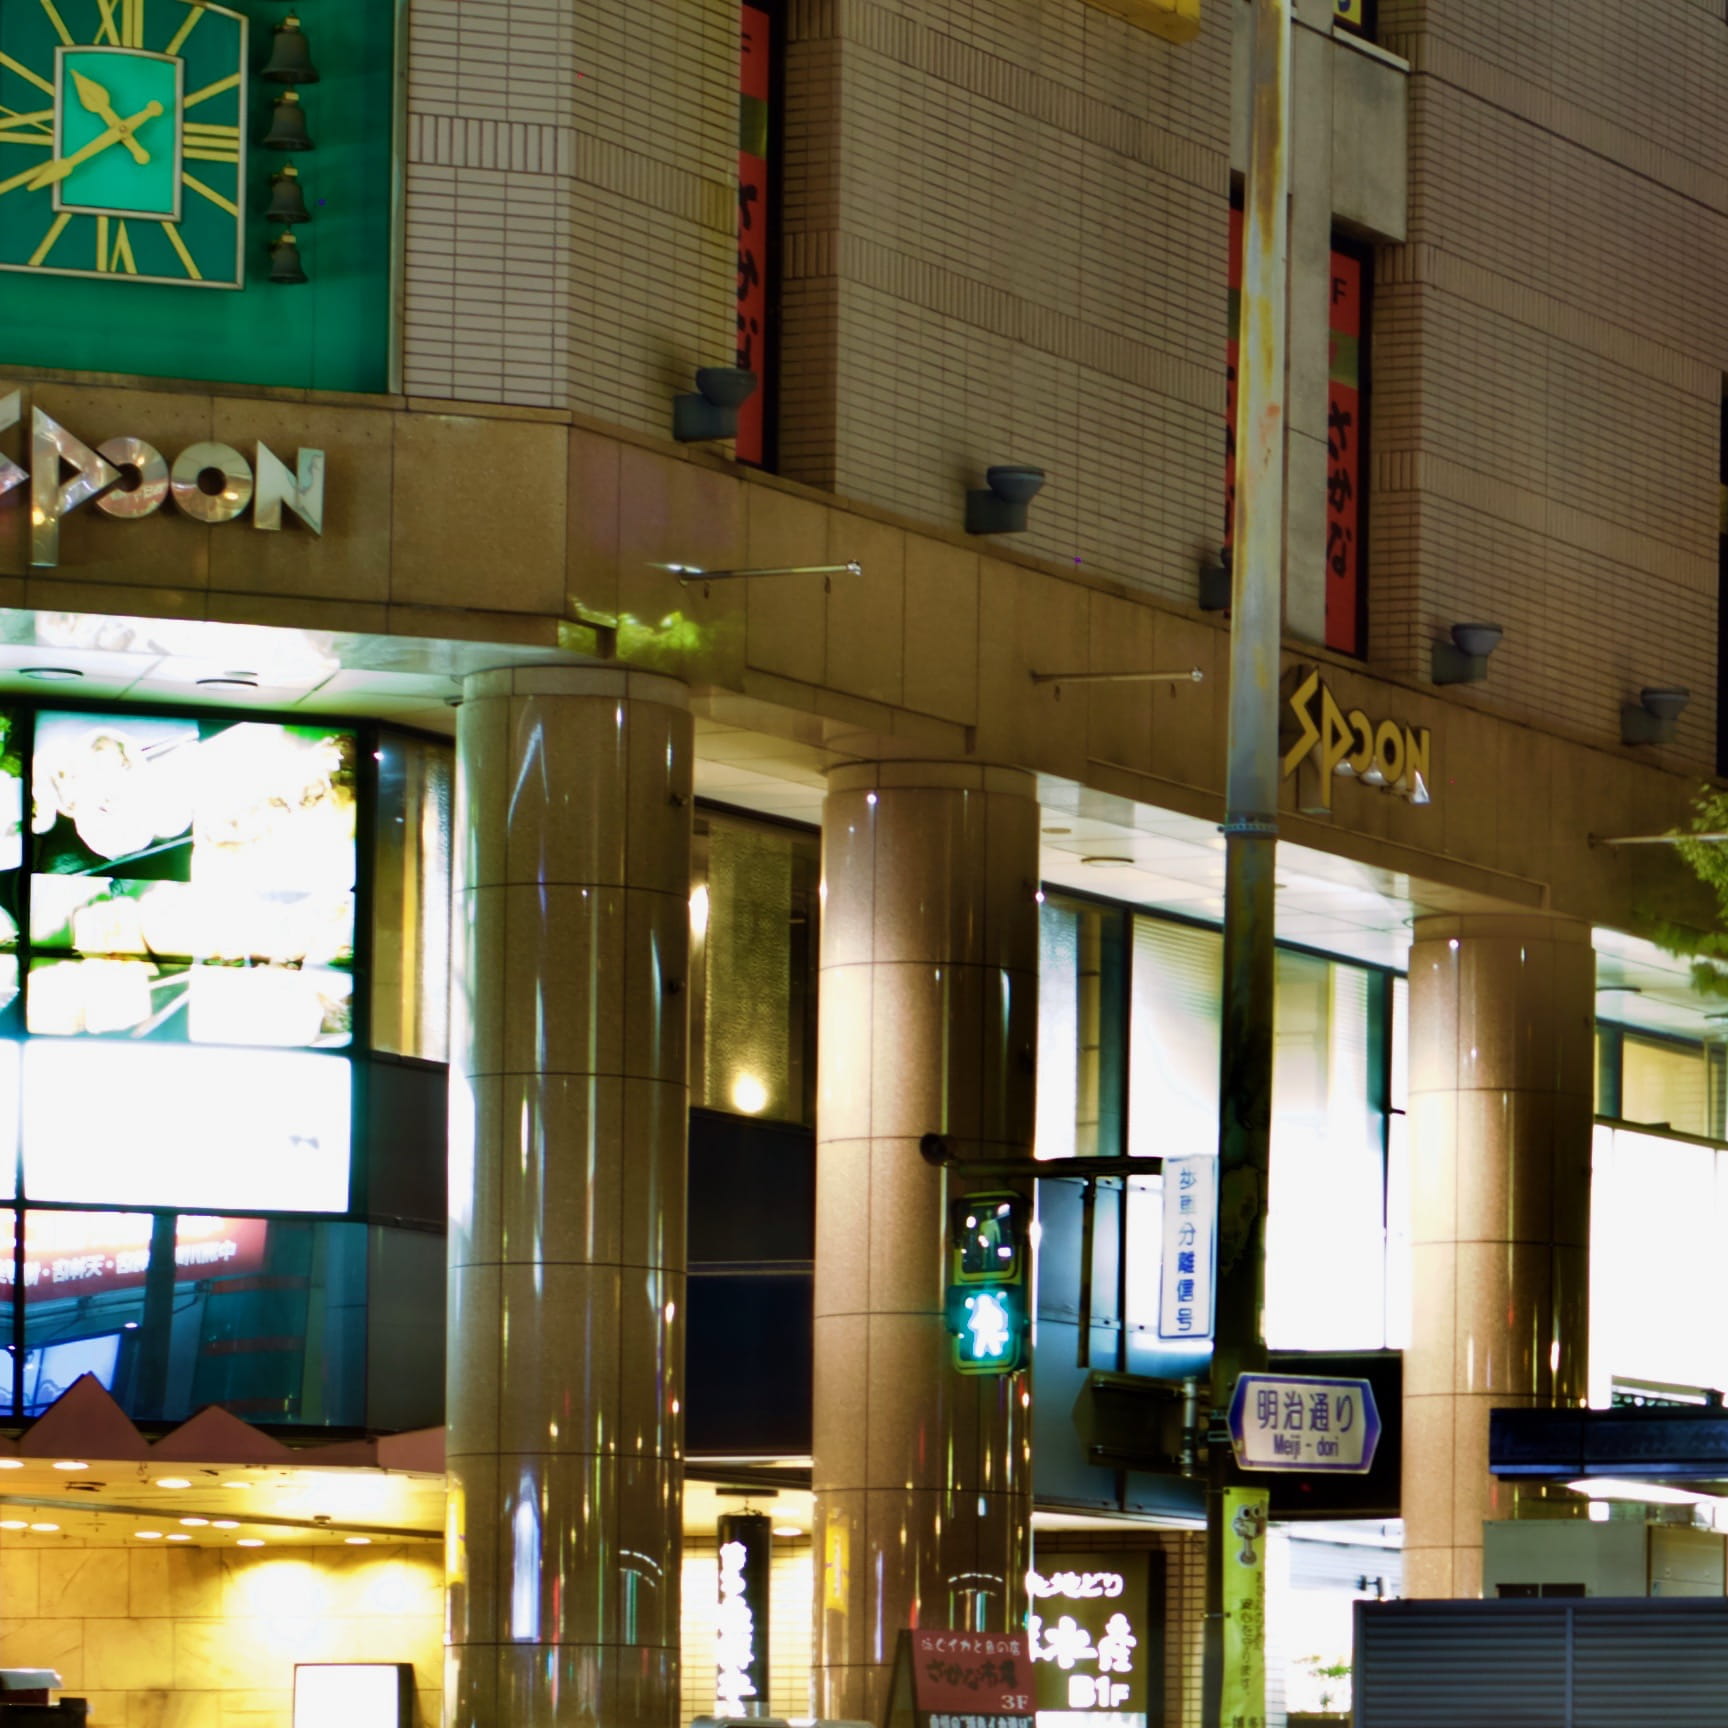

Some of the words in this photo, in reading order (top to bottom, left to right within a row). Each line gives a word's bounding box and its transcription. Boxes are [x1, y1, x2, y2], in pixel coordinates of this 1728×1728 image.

[0, 390, 325, 567] POON
[1257, 1389, 1355, 1433] 明治通り
[1001, 1695, 1029, 1710] 3F
